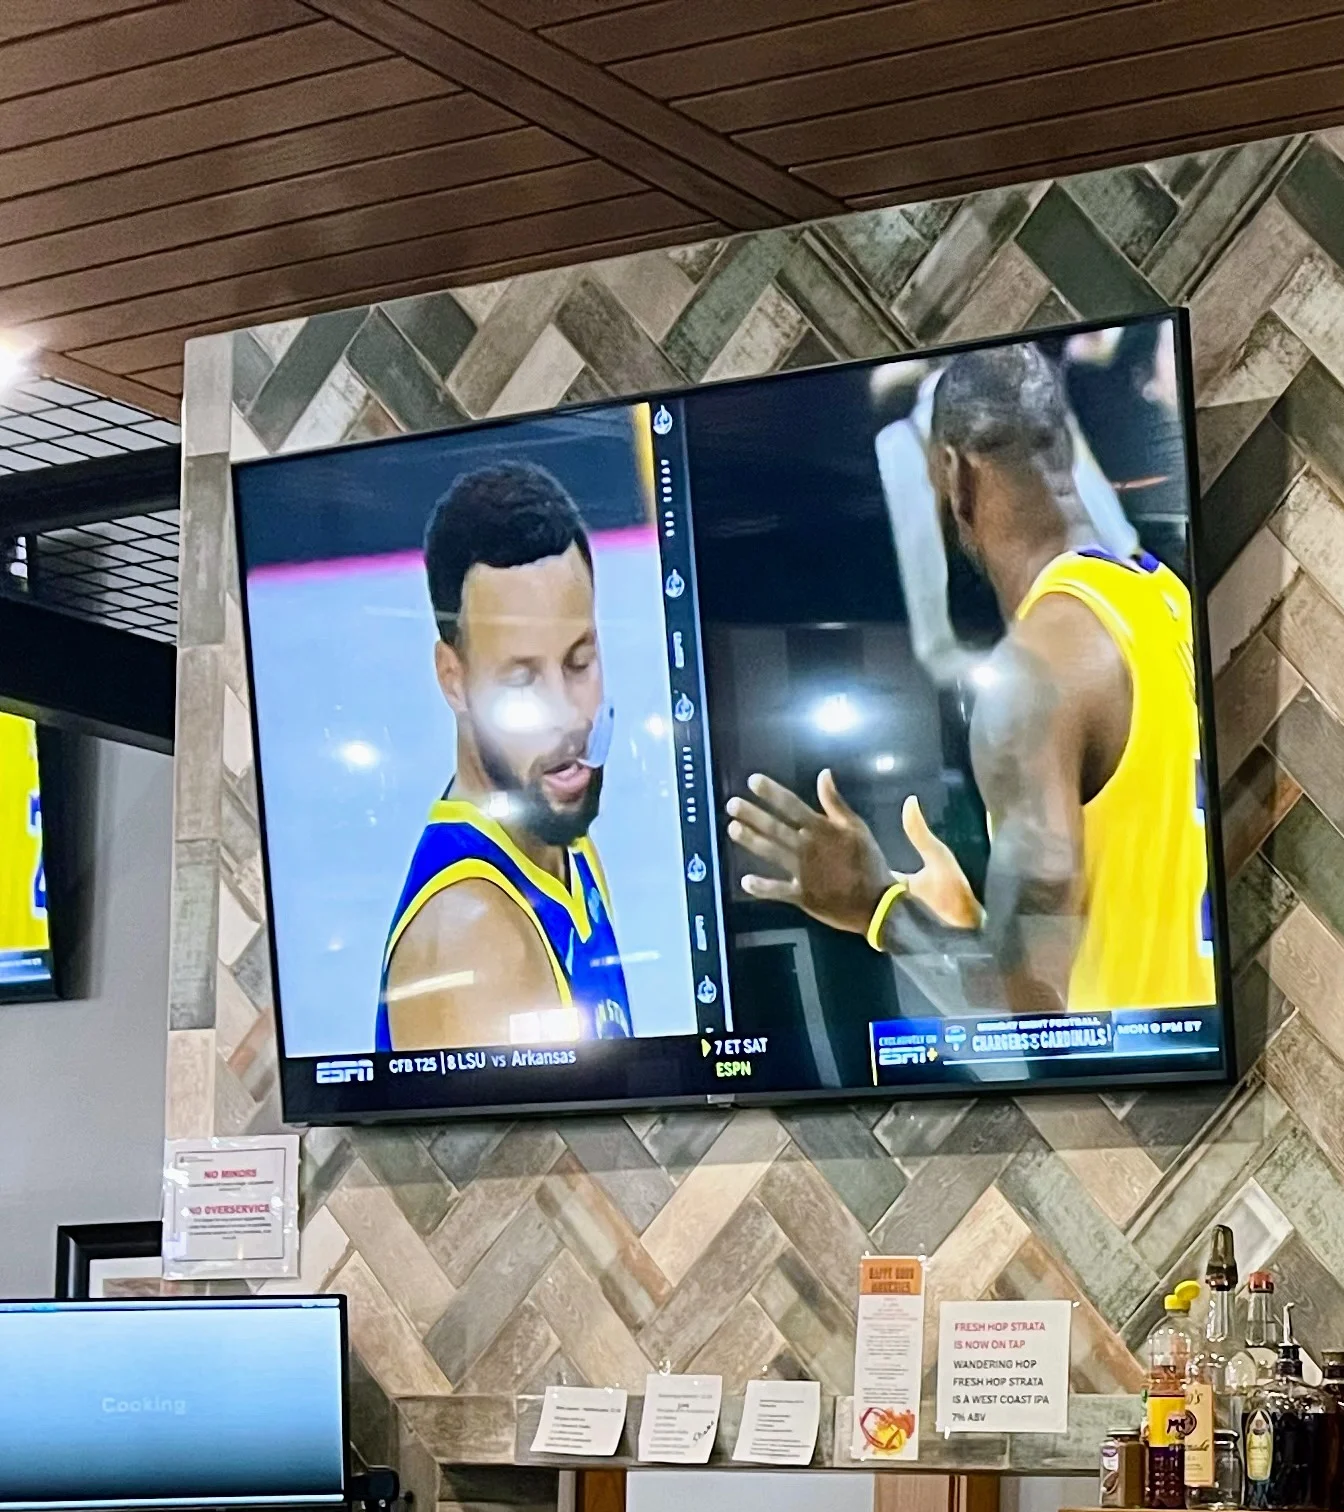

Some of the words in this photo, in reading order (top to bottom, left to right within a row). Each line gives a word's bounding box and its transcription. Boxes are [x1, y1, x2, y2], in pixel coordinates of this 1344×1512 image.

[715, 1041, 723, 1057] 7
[725, 1040, 740, 1056] ET
[743, 1038, 768, 1055] SAT
[457, 1052, 487, 1069] LSU
[492, 1055, 506, 1067] vs
[511, 1050, 577, 1067] Arkansas
[316, 1059, 374, 1083] ESPN
[717, 1062, 751, 1078] ESPN
[204, 1170, 218, 1178] NO
[221, 1169, 257, 1178] MINORS
[189, 1206, 202, 1214] NO
[204, 1203, 270, 1214] OVERSERVICE
[954, 1322, 985, 1331] FRESH
[987, 1322, 1008, 1331] HOP
[1011, 1322, 1046, 1331] STRATA
[954, 1340, 963, 1349] IS
[965, 1340, 989, 1349] NOW
[991, 1340, 1006, 1349] ON
[1008, 1340, 1025, 1349] TAP
[953, 1360, 1013, 1369] WANDERING
[1015, 1360, 1037, 1368] HOP
[953, 1378, 984, 1387] FRESH
[985, 1378, 1007, 1386] HOP
[1008, 1378, 1044, 1386] STRATA
[102, 1394, 187, 1414] Cooking
[952, 1395, 961, 1404] IS
[963, 1395, 970, 1404] A
[971, 1395, 997, 1404] WEST
[1000, 1395, 1031, 1404] COAST
[1034, 1395, 1050, 1404] IPA
